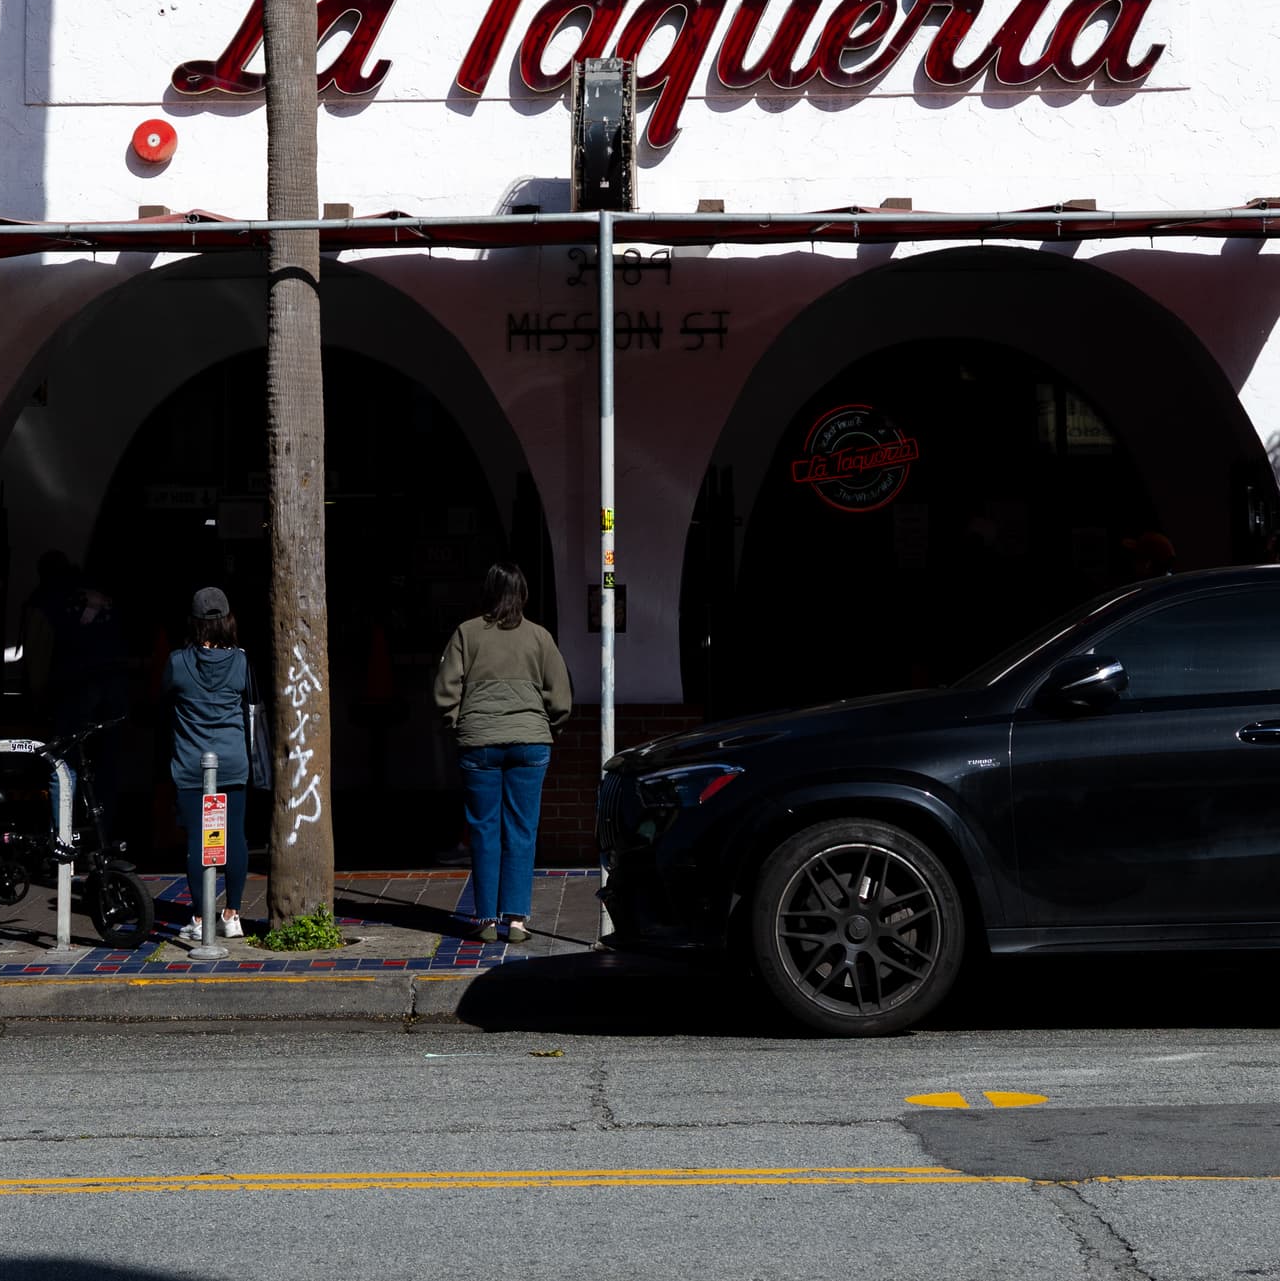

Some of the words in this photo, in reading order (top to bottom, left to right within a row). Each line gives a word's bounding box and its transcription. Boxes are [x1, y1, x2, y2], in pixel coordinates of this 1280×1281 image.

[568, 247, 671, 285] 289
[508, 311, 660, 352] MISSON
[682, 311, 730, 350] ST
